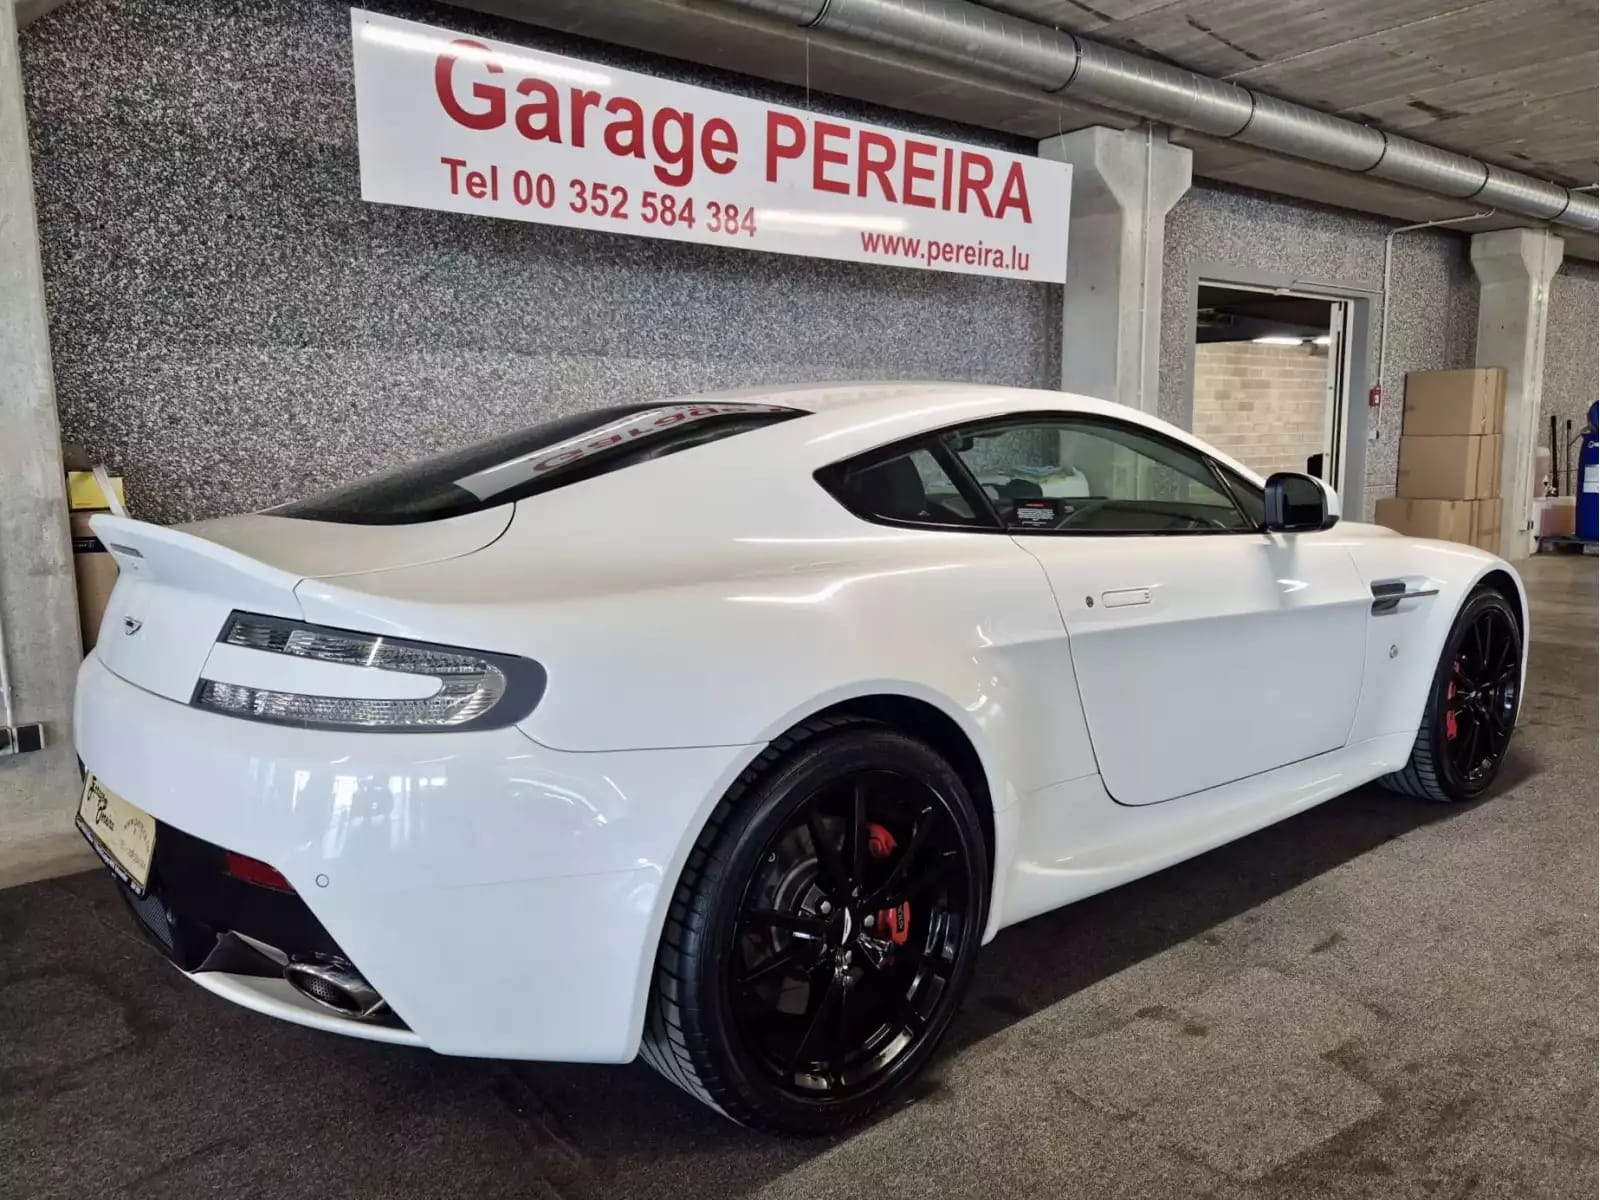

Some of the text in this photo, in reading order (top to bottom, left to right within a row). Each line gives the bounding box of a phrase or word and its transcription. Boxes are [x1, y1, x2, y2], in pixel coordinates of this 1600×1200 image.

[434, 38, 1033, 225] Garage PEREIRA
[441, 157, 757, 238] Tel 00 352 584 384
[860, 231, 1031, 273] www.pereira.lu
